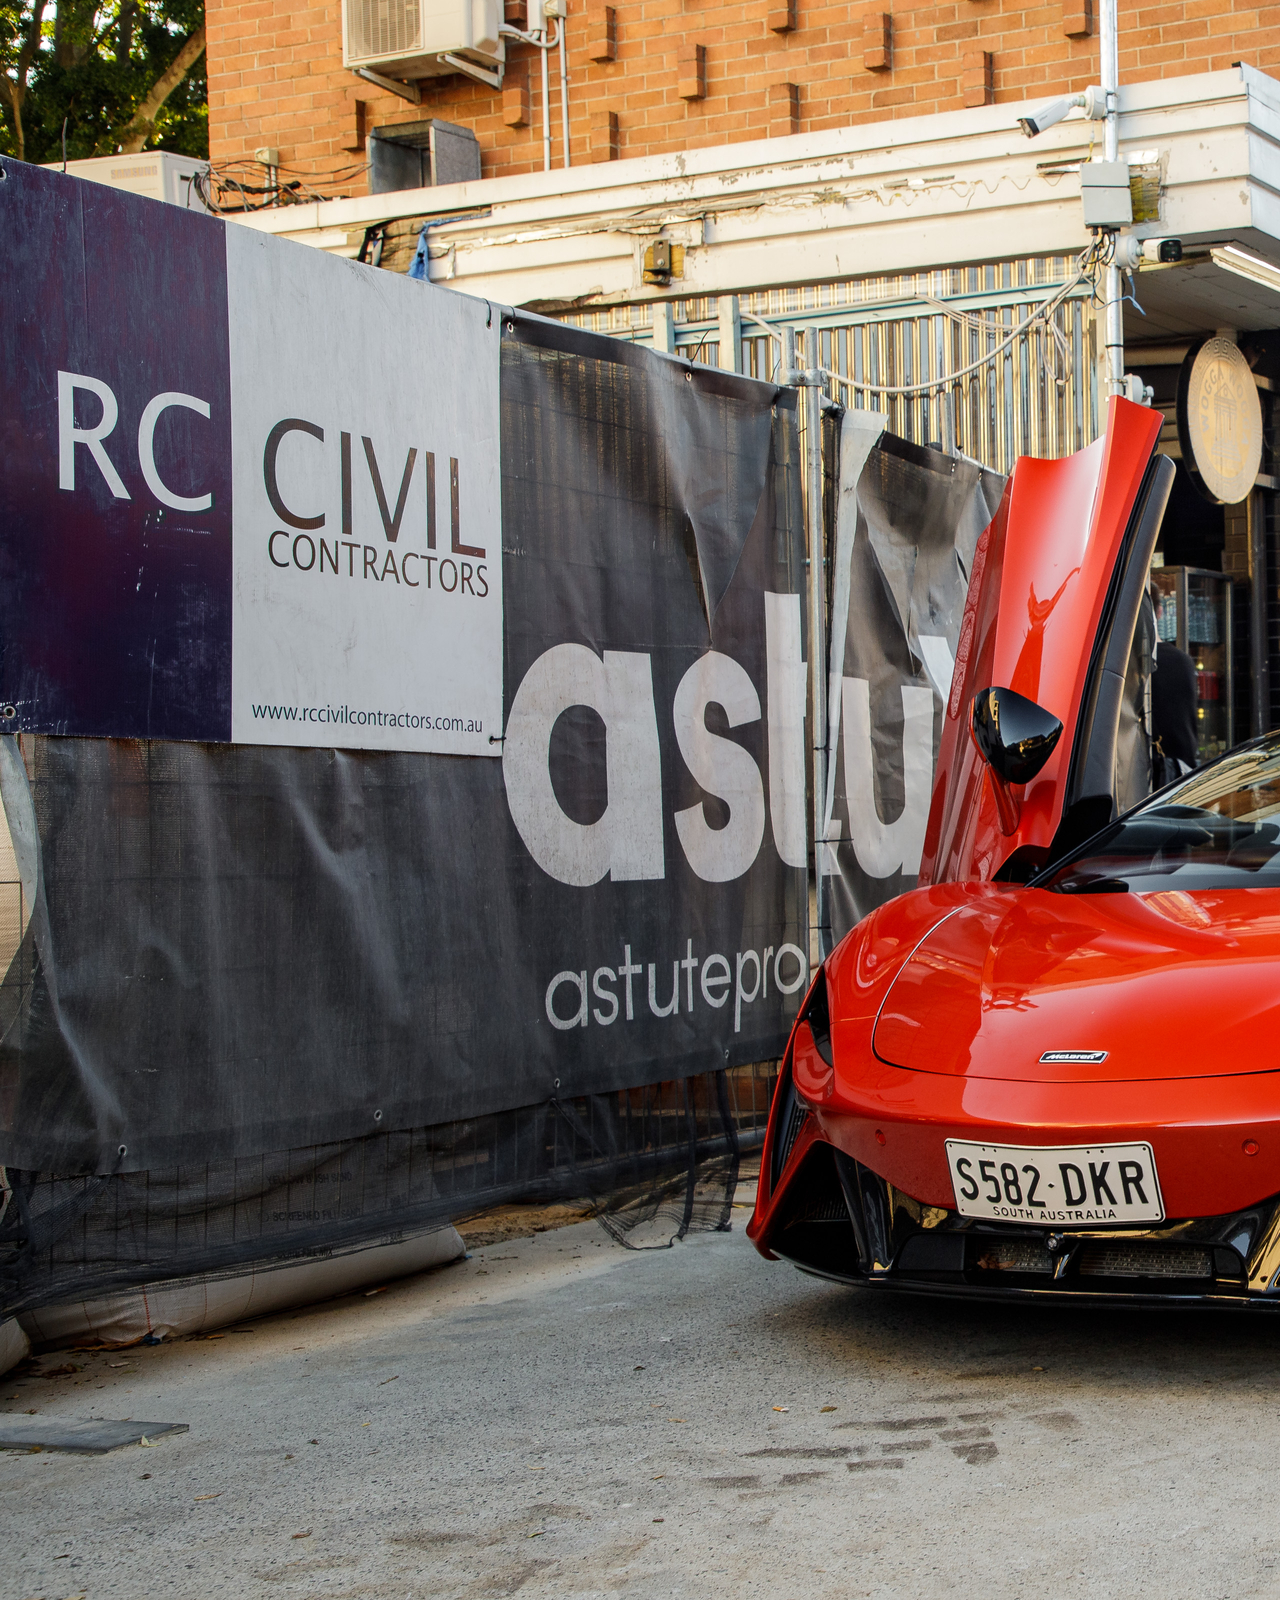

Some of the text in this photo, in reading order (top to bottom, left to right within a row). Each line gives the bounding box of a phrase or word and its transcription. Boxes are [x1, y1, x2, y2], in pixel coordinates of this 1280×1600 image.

[111, 165, 158, 180] SAMSUNG
[57, 370, 486, 559] RC CIVIL
[268, 530, 489, 598] CONTRACTORS
[252, 704, 483, 733] www.rccivilcontractors.com.au
[545, 938, 807, 1033] astutepro
[956, 1157, 1149, 1208] S582 DKR
[993, 1206, 1117, 1221] SOUTH AUSTRALIA
